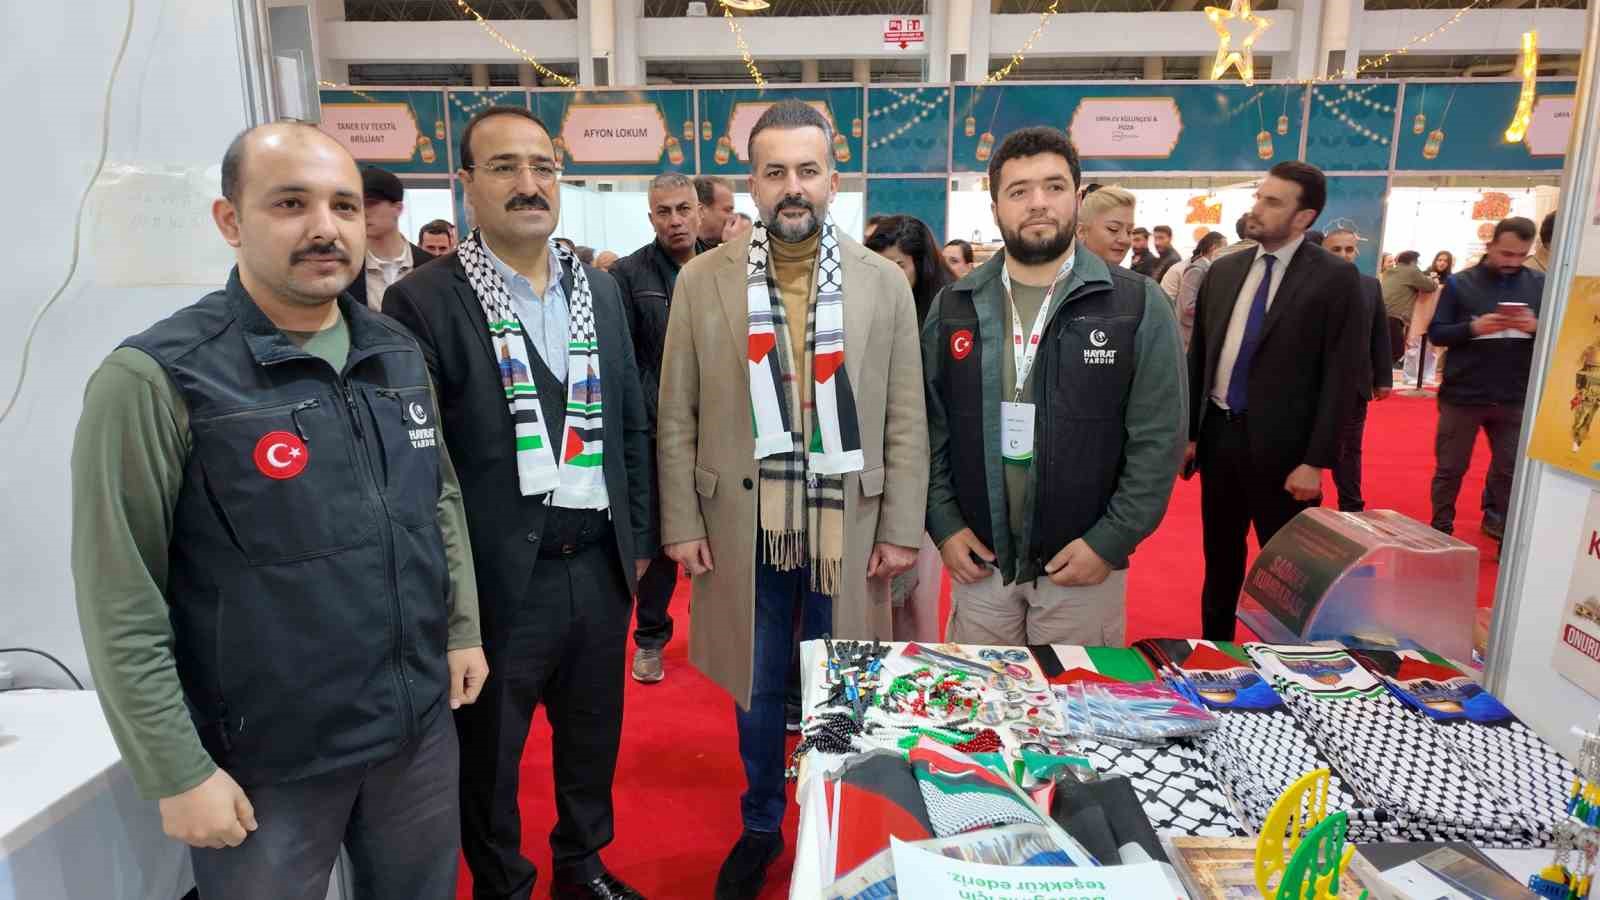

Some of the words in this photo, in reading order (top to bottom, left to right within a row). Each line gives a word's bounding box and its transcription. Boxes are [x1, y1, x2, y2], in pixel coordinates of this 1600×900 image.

[337, 122, 359, 131] TANER
[361, 122, 370, 131] EV
[583, 128, 613, 138] AFYON
[615, 128, 648, 137] LOKUM
[1083, 349, 1118, 358] HAYRAT
[1016, 878, 1107, 892] teşekkür
